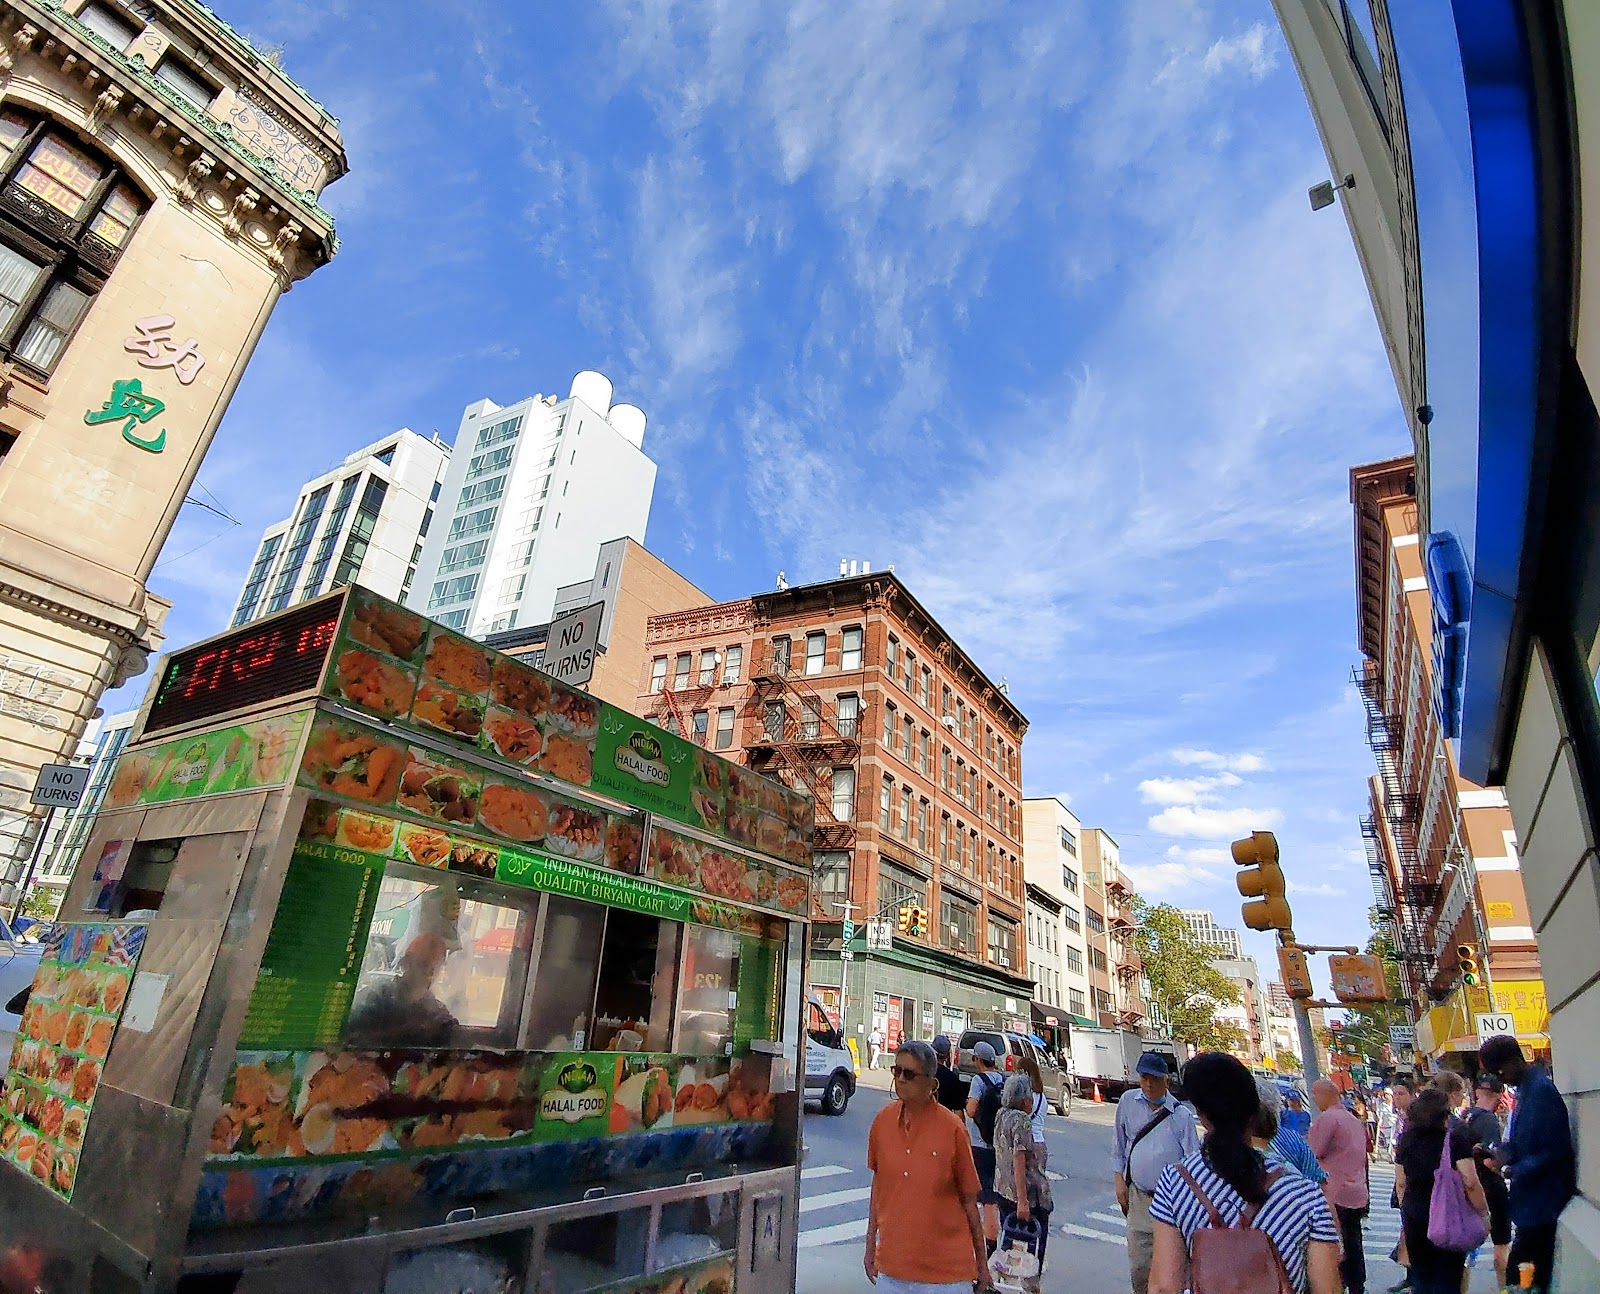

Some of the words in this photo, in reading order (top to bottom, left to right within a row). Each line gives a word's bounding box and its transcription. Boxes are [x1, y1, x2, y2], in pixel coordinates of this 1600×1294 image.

[560, 622, 584, 649] NO
[544, 649, 592, 678] TURNS
[631, 738, 660, 758] INDIAN
[617, 753, 645, 773] HALAL
[646, 765, 669, 782] FOOD
[52, 771, 73, 785] NO
[36, 786, 80, 802] TURNS
[593, 772, 631, 792] QUALITY
[633, 786, 666, 804] BIRYANI
[667, 799, 688, 814] CART
[333, 850, 366, 866] FOOD
[544, 857, 589, 878] INDIAN
[592, 870, 632, 889] HALAL
[632, 881, 661, 896] FOOD
[533, 870, 590, 895] QUALITY
[591, 884, 636, 907] BIRYANI
[638, 894, 666, 912] CART
[873, 926, 886, 935] NO
[868, 937, 890, 946] TURNS
[1482, 1018, 1508, 1031] NO
[560, 1070, 594, 1086] INDIAN
[543, 1098, 575, 1113] HALAL
[577, 1097, 605, 1111] FOOD
